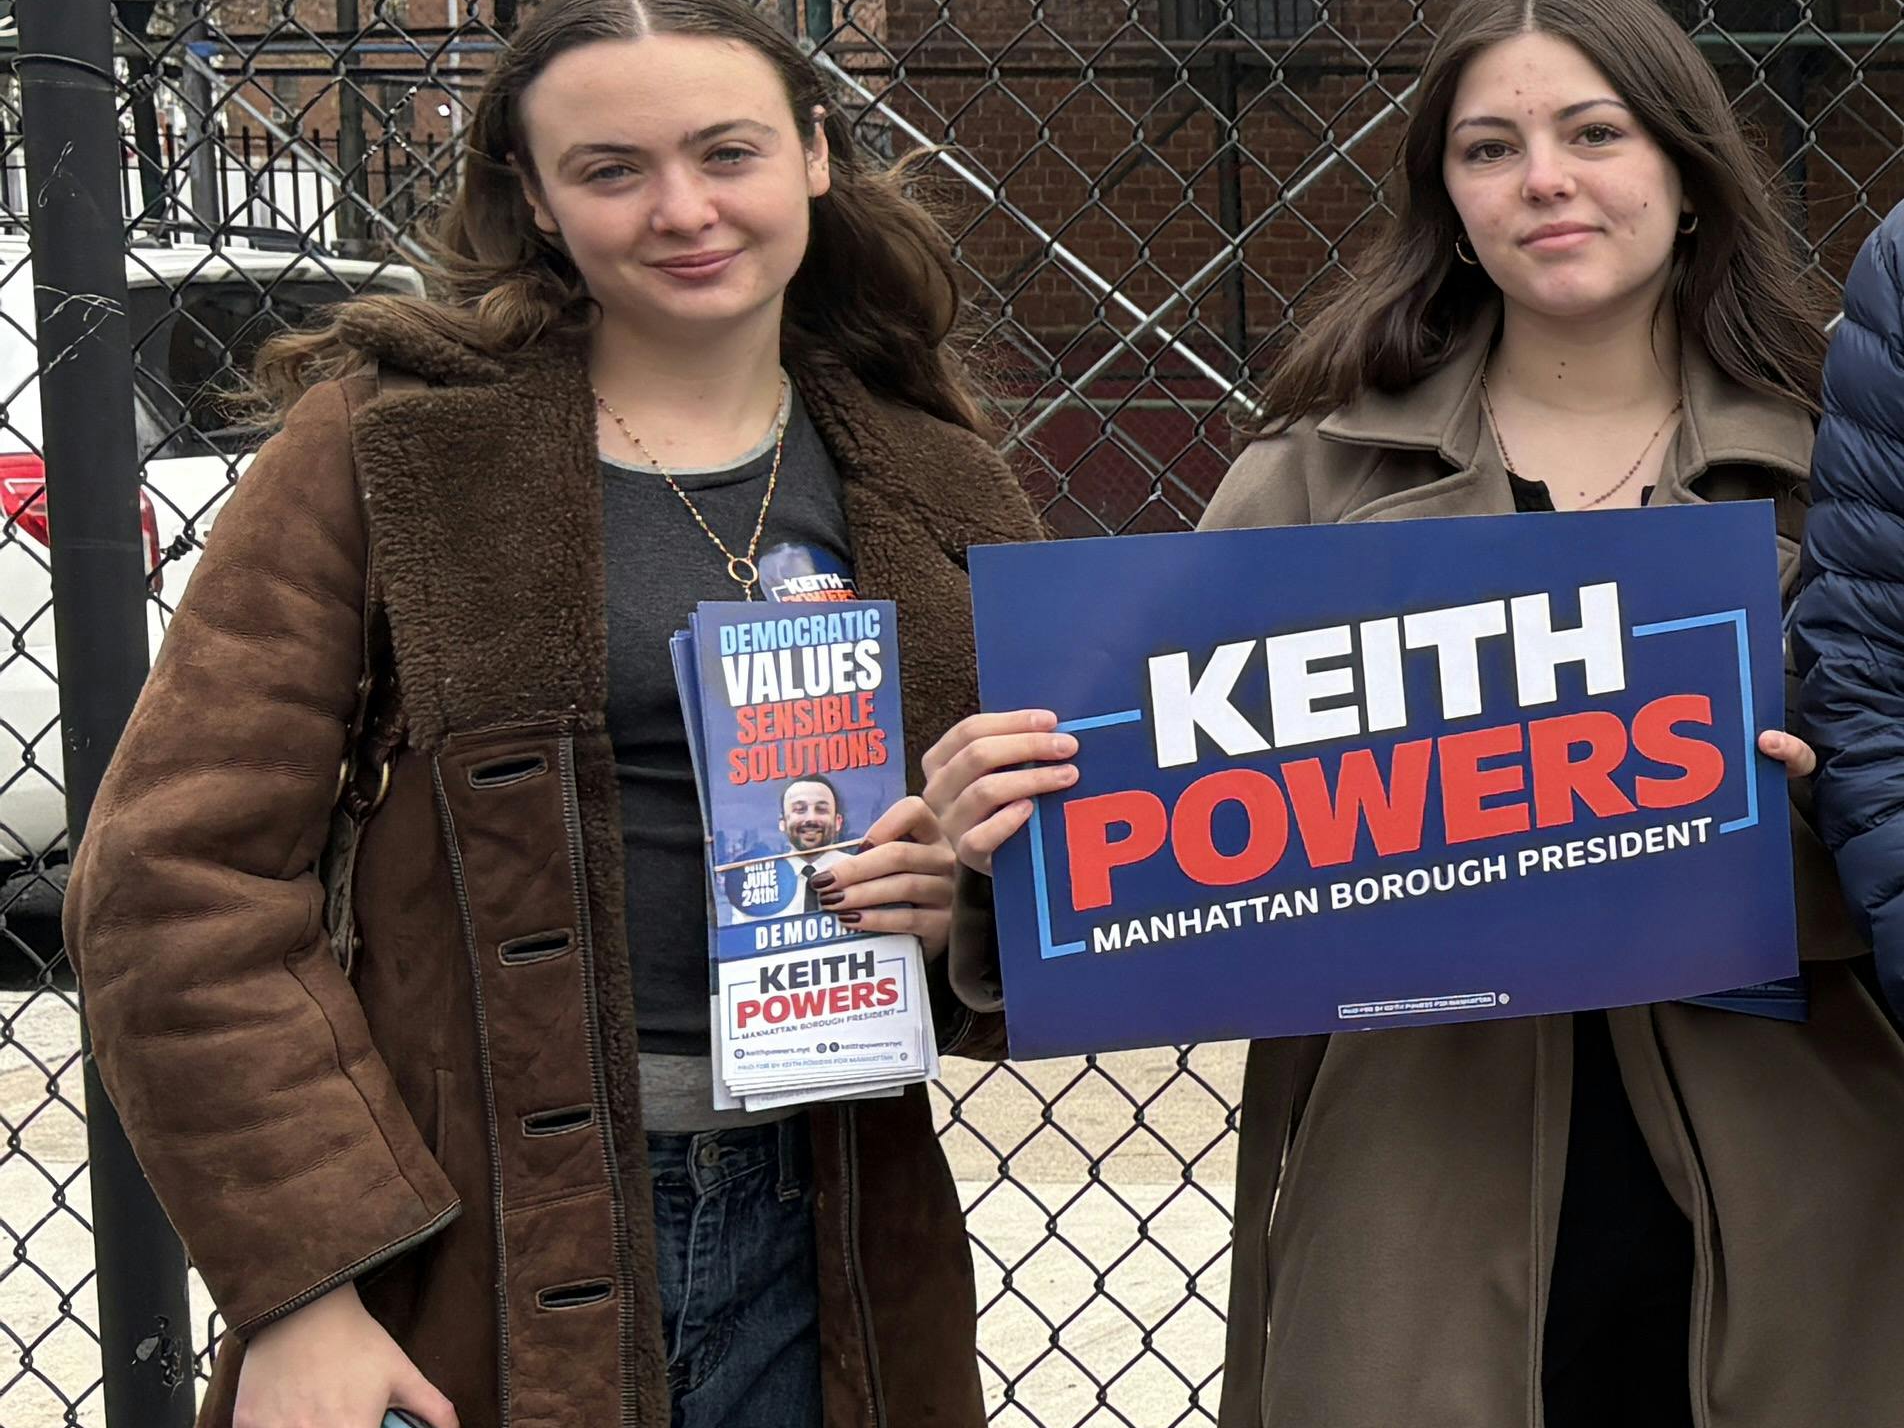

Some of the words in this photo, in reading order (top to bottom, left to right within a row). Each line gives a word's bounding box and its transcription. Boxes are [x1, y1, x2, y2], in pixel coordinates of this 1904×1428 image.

[784, 573, 843, 594] KEITH
[720, 608, 881, 656] DEMOCRATIC
[721, 639, 882, 707] VALUES
[1148, 581, 1626, 769] KEITH
[736, 692, 875, 745] SENSIBLE
[728, 728, 888, 786] SOLUTIONS
[1063, 694, 1725, 911] POWERS
[743, 869, 776, 890] JUNE
[1092, 887, 1320, 954] MANHATTAN
[1331, 855, 1507, 911] BOROUGH
[1518, 817, 1714, 877] PRESIDENT
[755, 914, 850, 951] DEMOC
[760, 950, 876, 994] KEITH
[737, 977, 899, 1029] POWERS
[742, 1025, 798, 1039] MANHATTAN
[800, 1018, 844, 1030] BOROUGH
[847, 1008, 895, 1022] PRESIDENT
